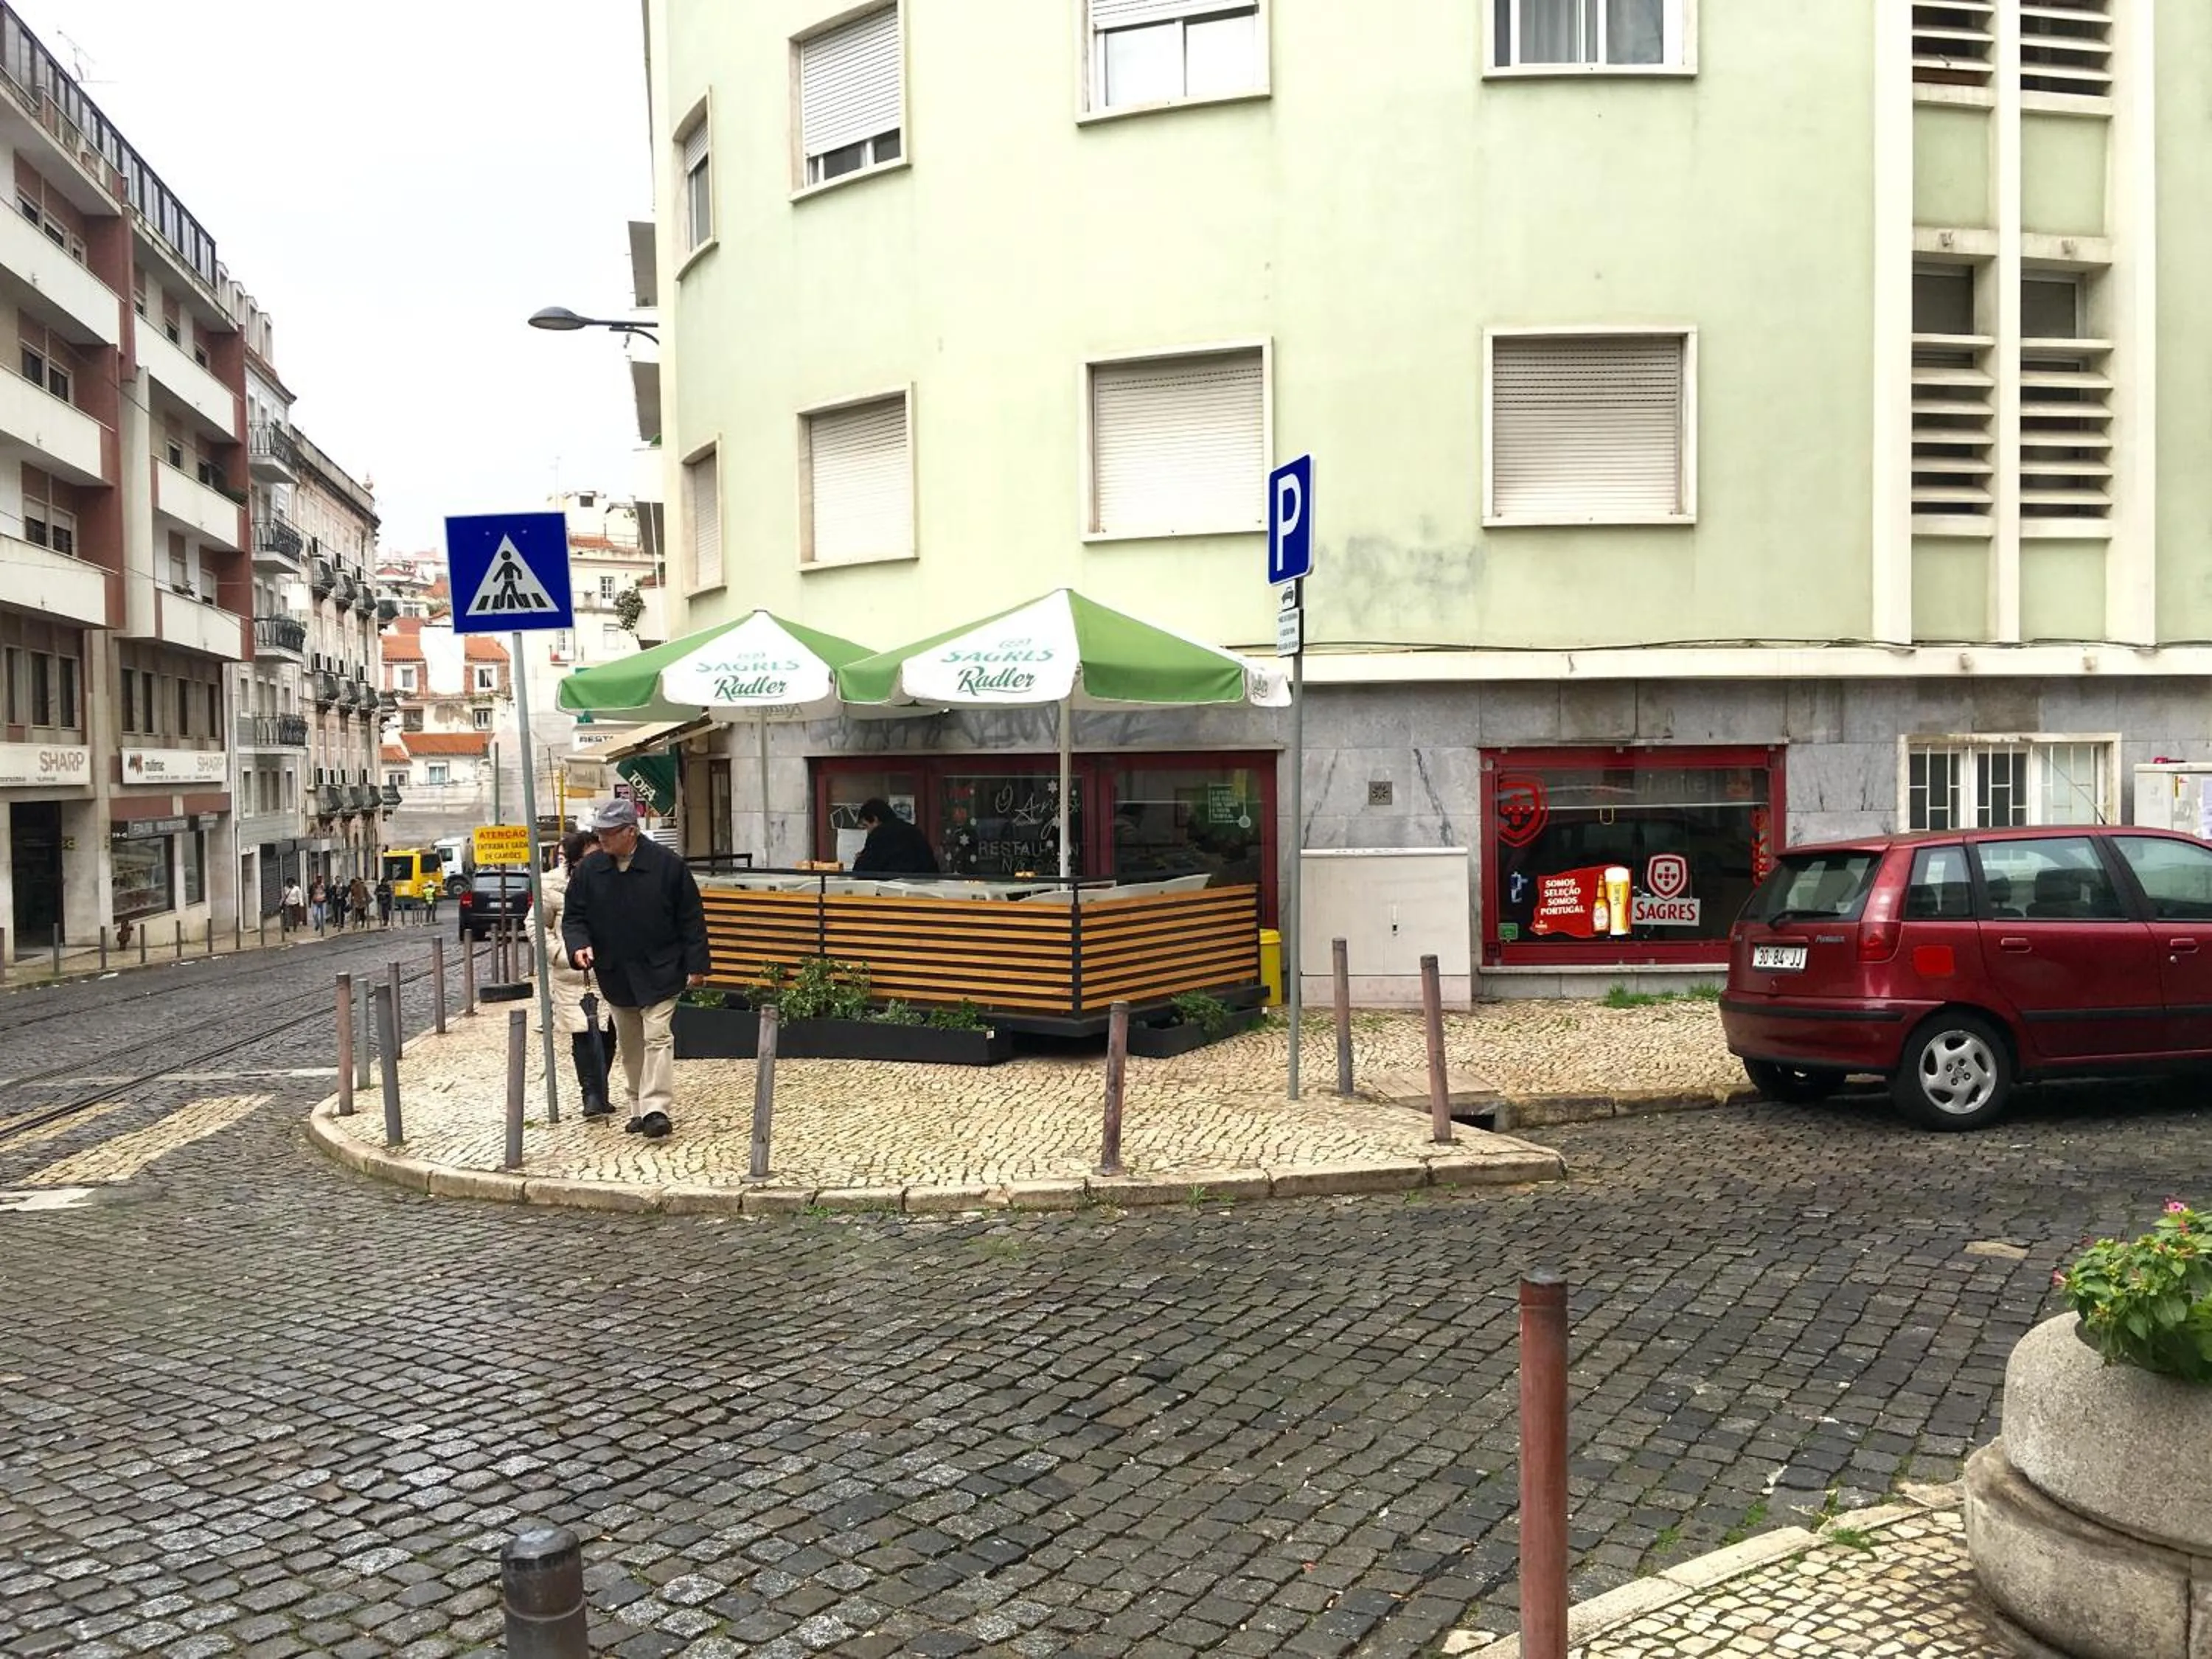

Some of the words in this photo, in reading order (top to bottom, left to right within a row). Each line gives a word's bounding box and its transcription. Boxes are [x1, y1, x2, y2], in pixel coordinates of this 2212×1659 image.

[1276, 473, 1301, 572] P
[714, 675, 787, 702] Radler
[956, 666, 1036, 697] Radler
[39, 751, 85, 773] SHARP
[628, 769, 656, 802] TOFA
[1545, 878, 1576, 888] SOMOS
[1540, 905, 1585, 916] PORTUGAL
[1548, 897, 1578, 906] SOMOS
[1635, 901, 1695, 921] SAGRES
